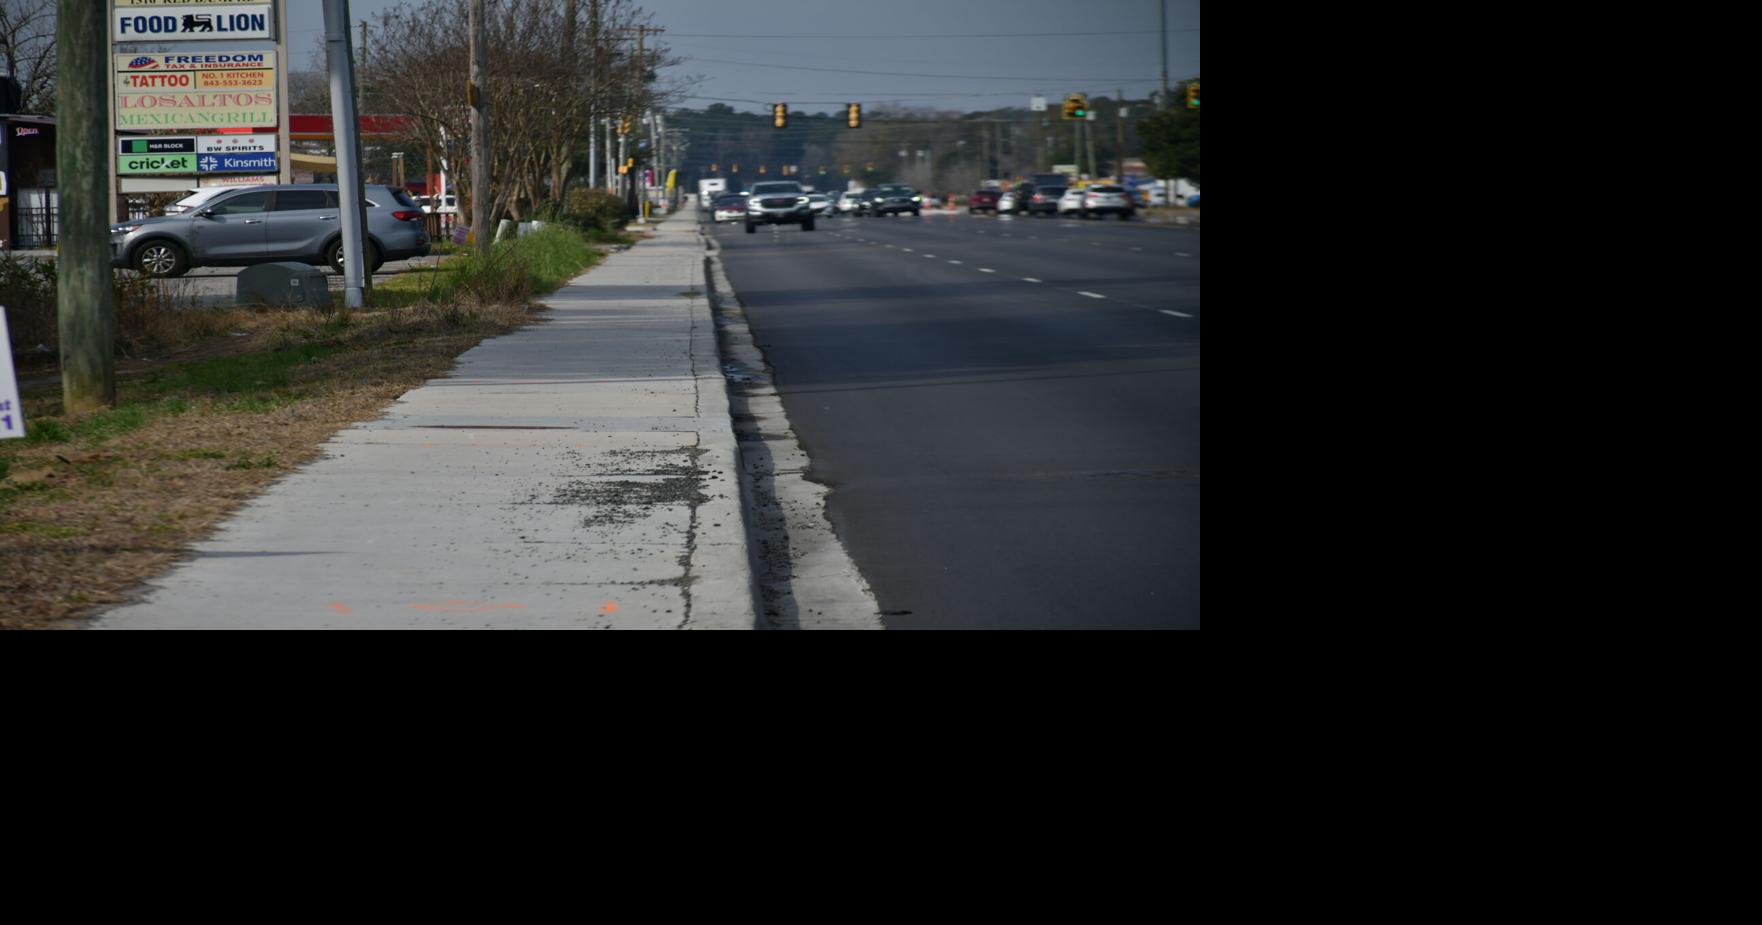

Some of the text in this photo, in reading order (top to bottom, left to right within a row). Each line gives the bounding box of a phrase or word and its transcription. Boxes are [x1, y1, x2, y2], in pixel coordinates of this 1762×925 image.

[120, 13, 265, 34] FOOD LION
[164, 54, 263, 63] FREEDOM
[130, 74, 190, 87] TATTOO
[128, 157, 188, 170] cricket
[224, 157, 276, 168] Kinsmith
